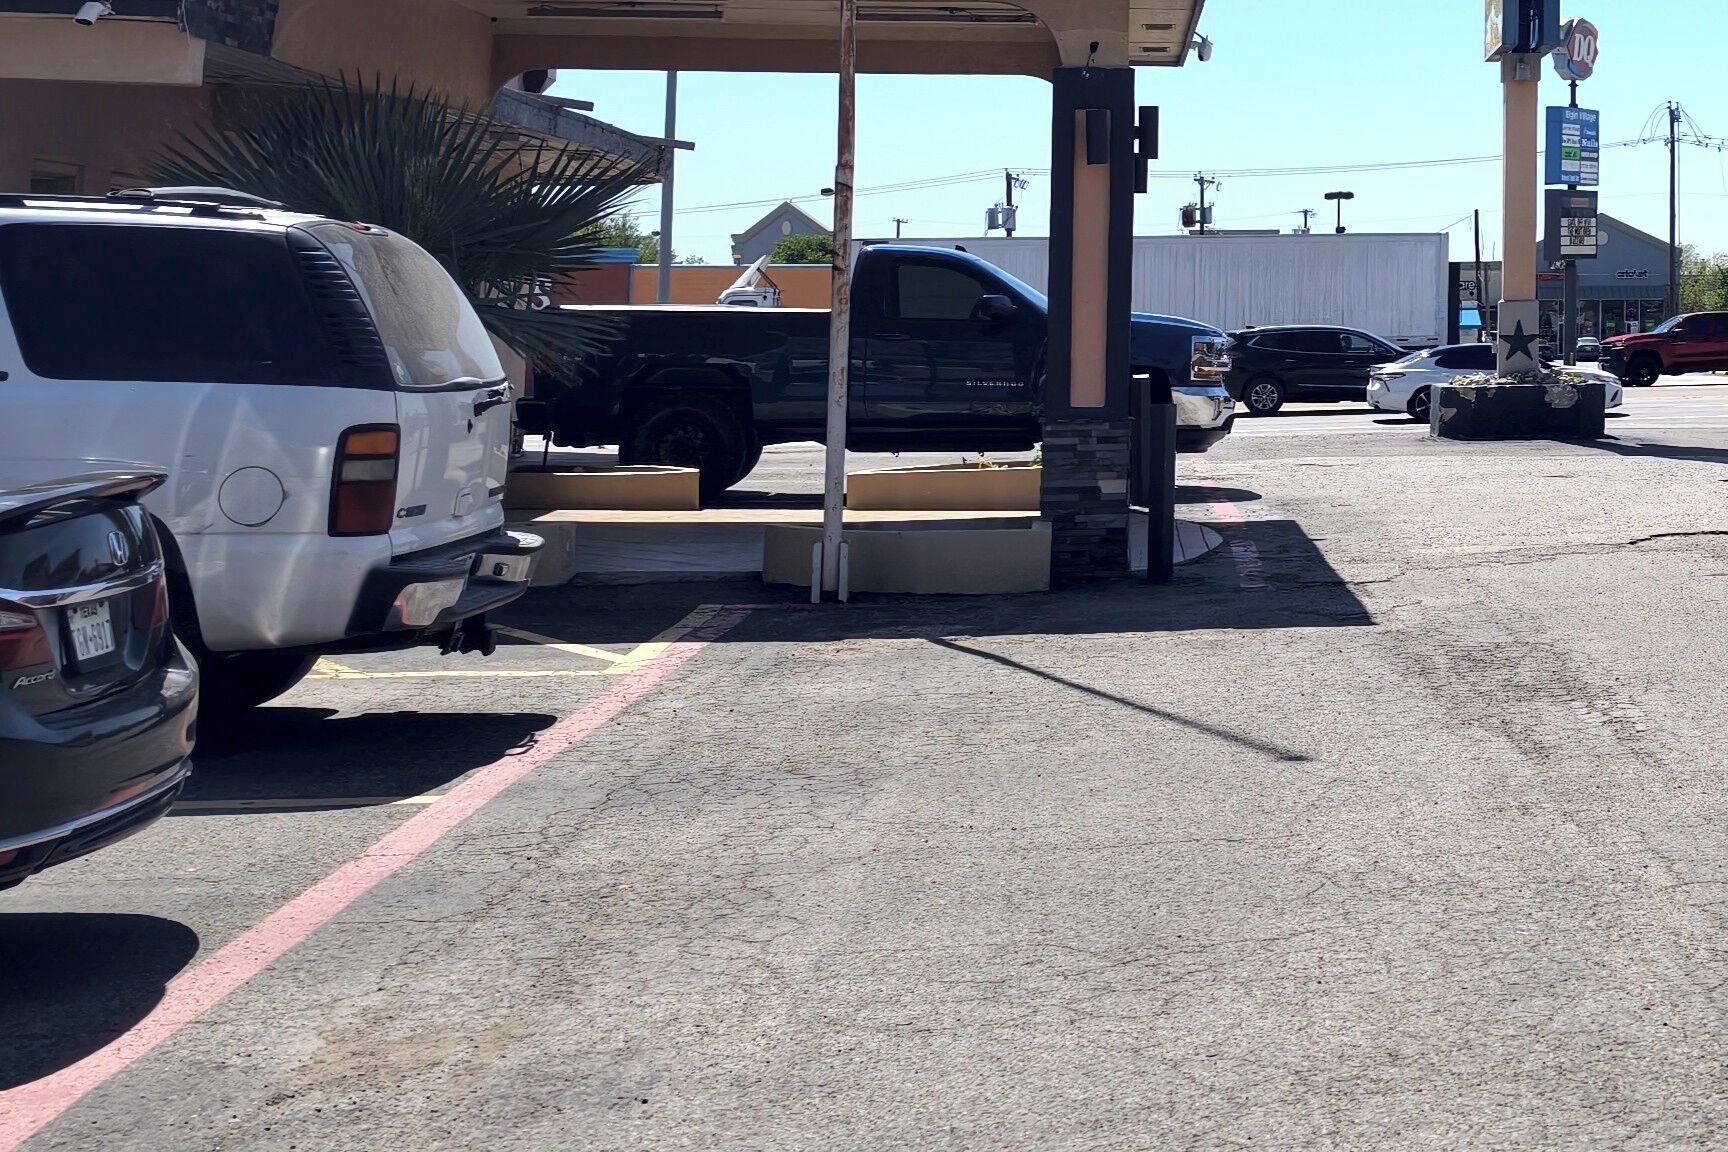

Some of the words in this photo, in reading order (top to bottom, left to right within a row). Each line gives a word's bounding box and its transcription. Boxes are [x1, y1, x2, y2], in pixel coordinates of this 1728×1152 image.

[1573, 33, 1597, 68] DQ
[1565, 110, 1579, 120] Elgin
[1580, 111, 1597, 123] Village
[1459, 280, 1477, 291] are
[13, 669, 56, 689] Accord
